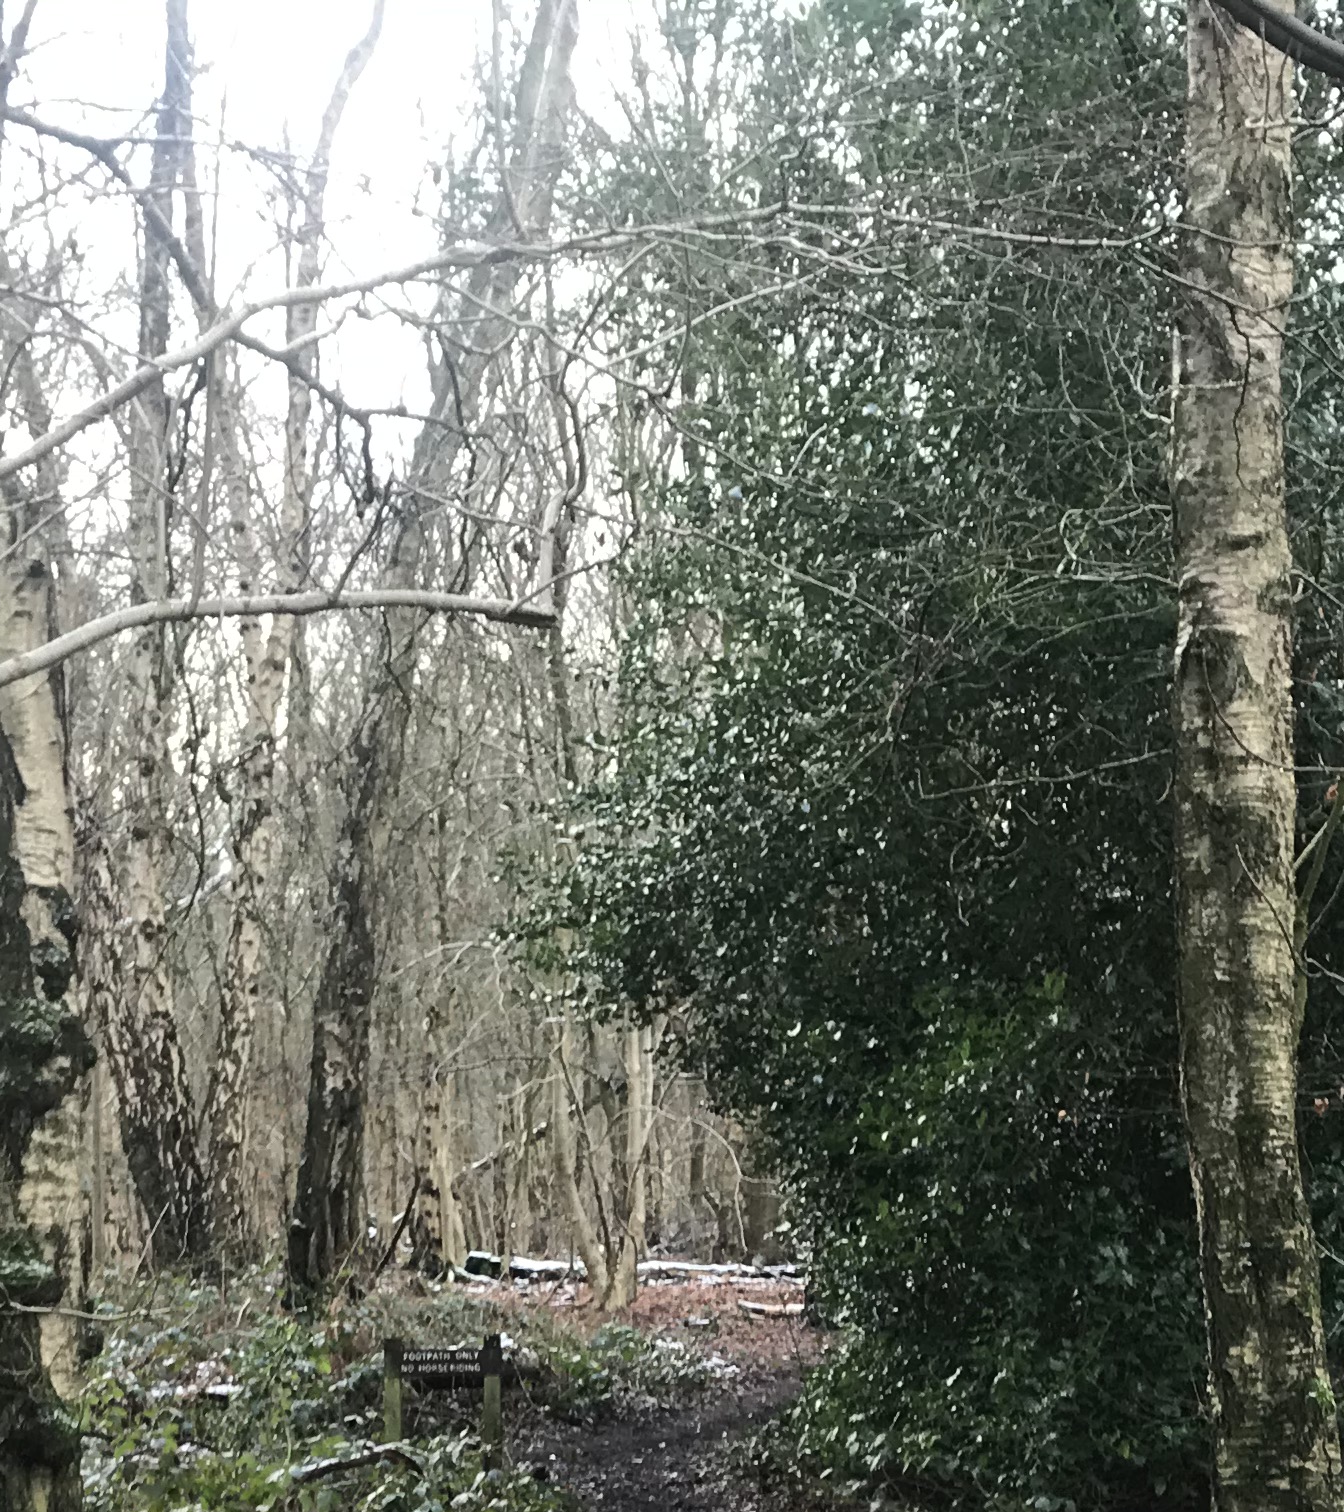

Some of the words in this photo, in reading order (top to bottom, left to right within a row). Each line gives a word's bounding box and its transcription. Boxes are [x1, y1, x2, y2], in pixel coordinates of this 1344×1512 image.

[403, 1351, 451, 1361] FOOTPATH
[455, 1350, 479, 1361] ONLY
[401, 1363, 415, 1373] NO
